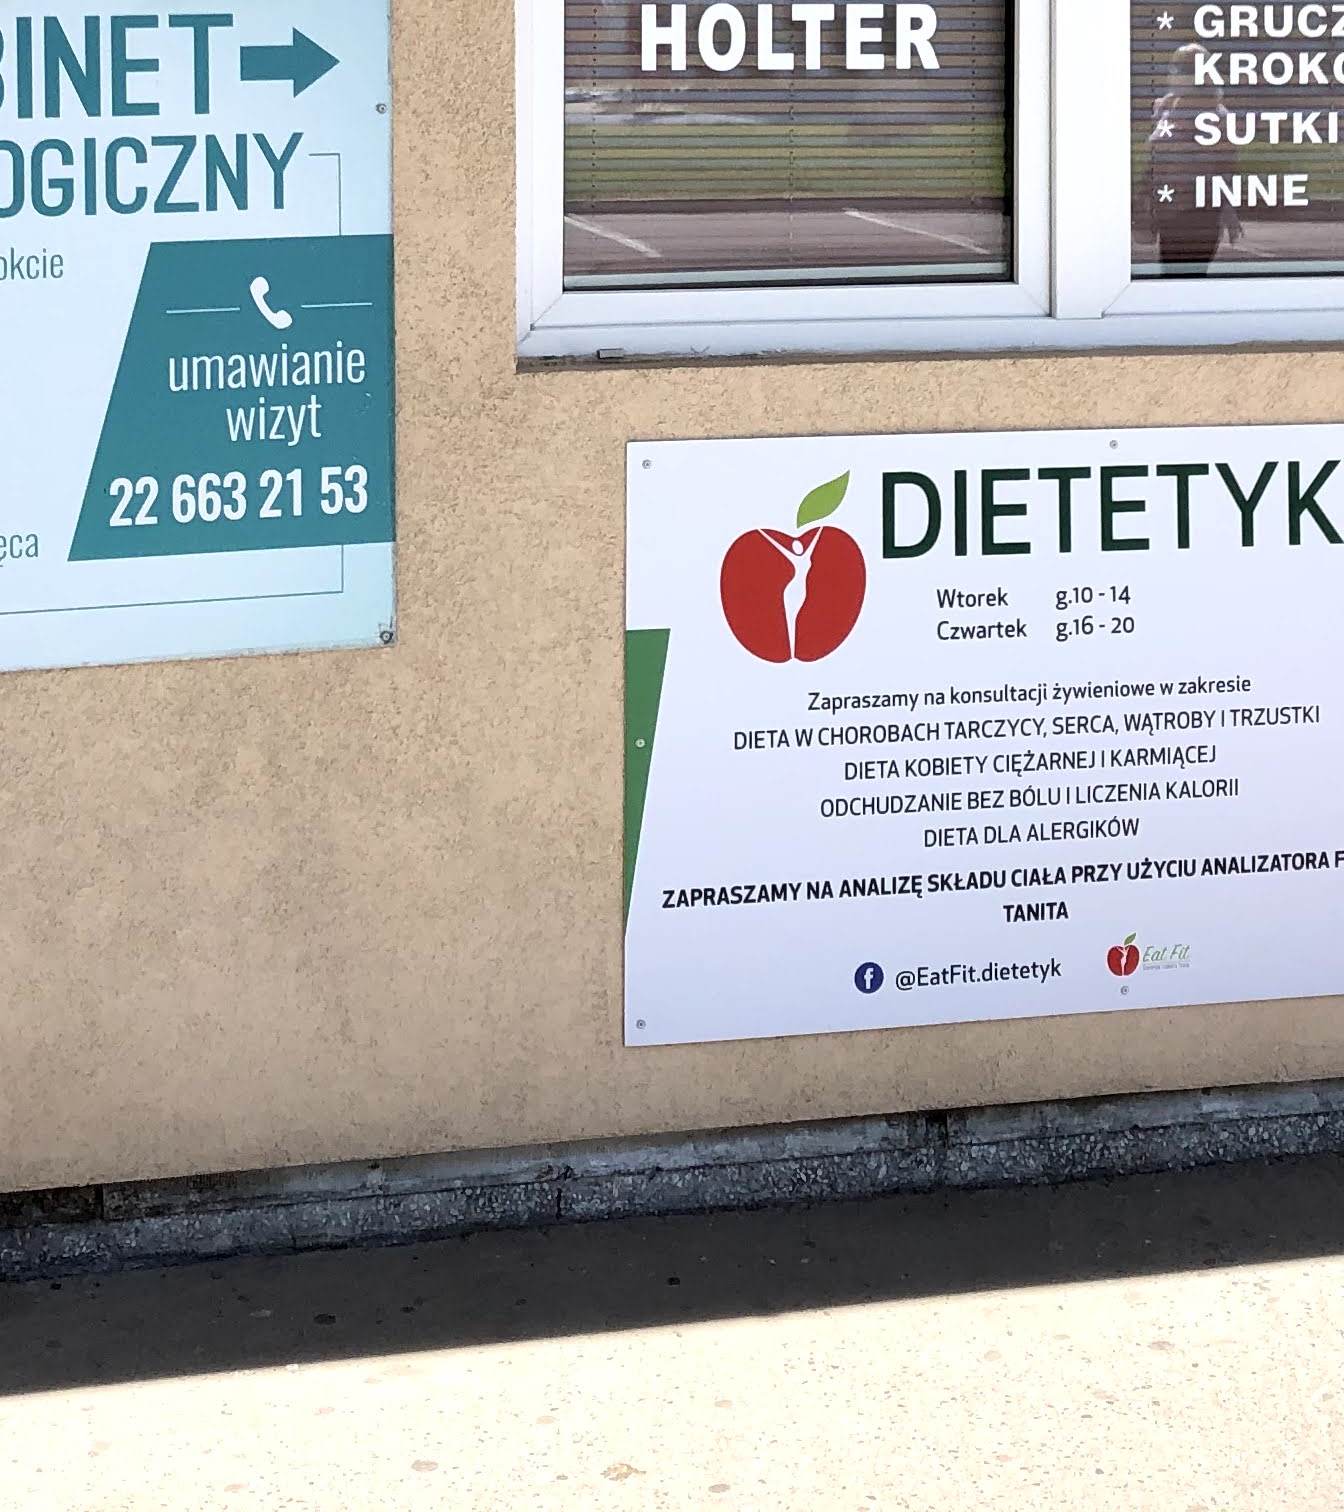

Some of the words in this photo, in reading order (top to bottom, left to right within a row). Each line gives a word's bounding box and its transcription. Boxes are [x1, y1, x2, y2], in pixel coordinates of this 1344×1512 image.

[639, 2, 940, 72] HOLTER
[1193, 111, 1339, 145] SUTKI
[1195, 174, 1309, 208] INNE
[169, 340, 366, 392] umawianie
[226, 394, 322, 447] wizyt
[109, 476, 159, 527] 22
[172, 471, 247, 523] 663
[259, 468, 303, 518] 21
[320, 464, 368, 515] 53
[882, 460, 1344, 559] DIETETYK
[937, 587, 1008, 609] Wtorek
[1056, 586, 1093, 611] g.10
[1110, 585, 1131, 606] 14
[937, 619, 1027, 642] Czwartek
[1056, 617, 1094, 642] g.16
[1111, 616, 1135, 636] 20
[808, 691, 918, 715] Zapraszamy
[924, 692, 945, 706] na
[950, 684, 1047, 707] konsultacji
[1054, 680, 1155, 705] żywieniowe
[1159, 682, 1173, 695] w
[1178, 675, 1251, 695] zakresie
[734, 729, 790, 750] DIETA
[796, 728, 813, 747] W
[818, 722, 940, 746] CHOROBACH
[944, 718, 1047, 739] TARCZYCY,
[1052, 714, 1119, 736] SERCA,
[1124, 710, 1216, 736] WĄTROBY
[1221, 709, 1225, 727] I
[1230, 705, 1320, 726] TRZUSTKI
[844, 760, 900, 781] DIETA
[905, 755, 988, 778] KOBIETY
[993, 749, 1096, 777] CIĘŻARNEJ
[1101, 750, 1105, 768] I
[1110, 745, 1216, 769] KARMIĄCEJ
[821, 792, 962, 818] ODCHUDZANIE
[967, 790, 1005, 810] BEZ
[1010, 785, 1061, 808] BÓLU
[1066, 786, 1070, 805] I
[1075, 782, 1161, 804] LICZENIA
[1166, 778, 1238, 800] KALORII
[924, 826, 979, 848] DIETA
[984, 824, 1022, 844] DLA
[1026, 816, 1140, 842] ALERGIKÓW
[662, 882, 802, 909] ZAPRASZAMY
[806, 880, 834, 900] NA
[839, 875, 923, 899] ANALIZĘ
[927, 870, 1007, 893] SKŁADU
[1011, 867, 1066, 888] CIAŁA
[1071, 862, 1122, 884] PRZY
[1126, 857, 1197, 881] UŻYCIU
[1201, 851, 1330, 877] ANALIZATORA
[1003, 901, 1069, 924] TANITA
[1142, 945, 1167, 963] Eat
[1170, 943, 1191, 961] Fit
[895, 957, 1062, 991] @EatFit.dietetyk
